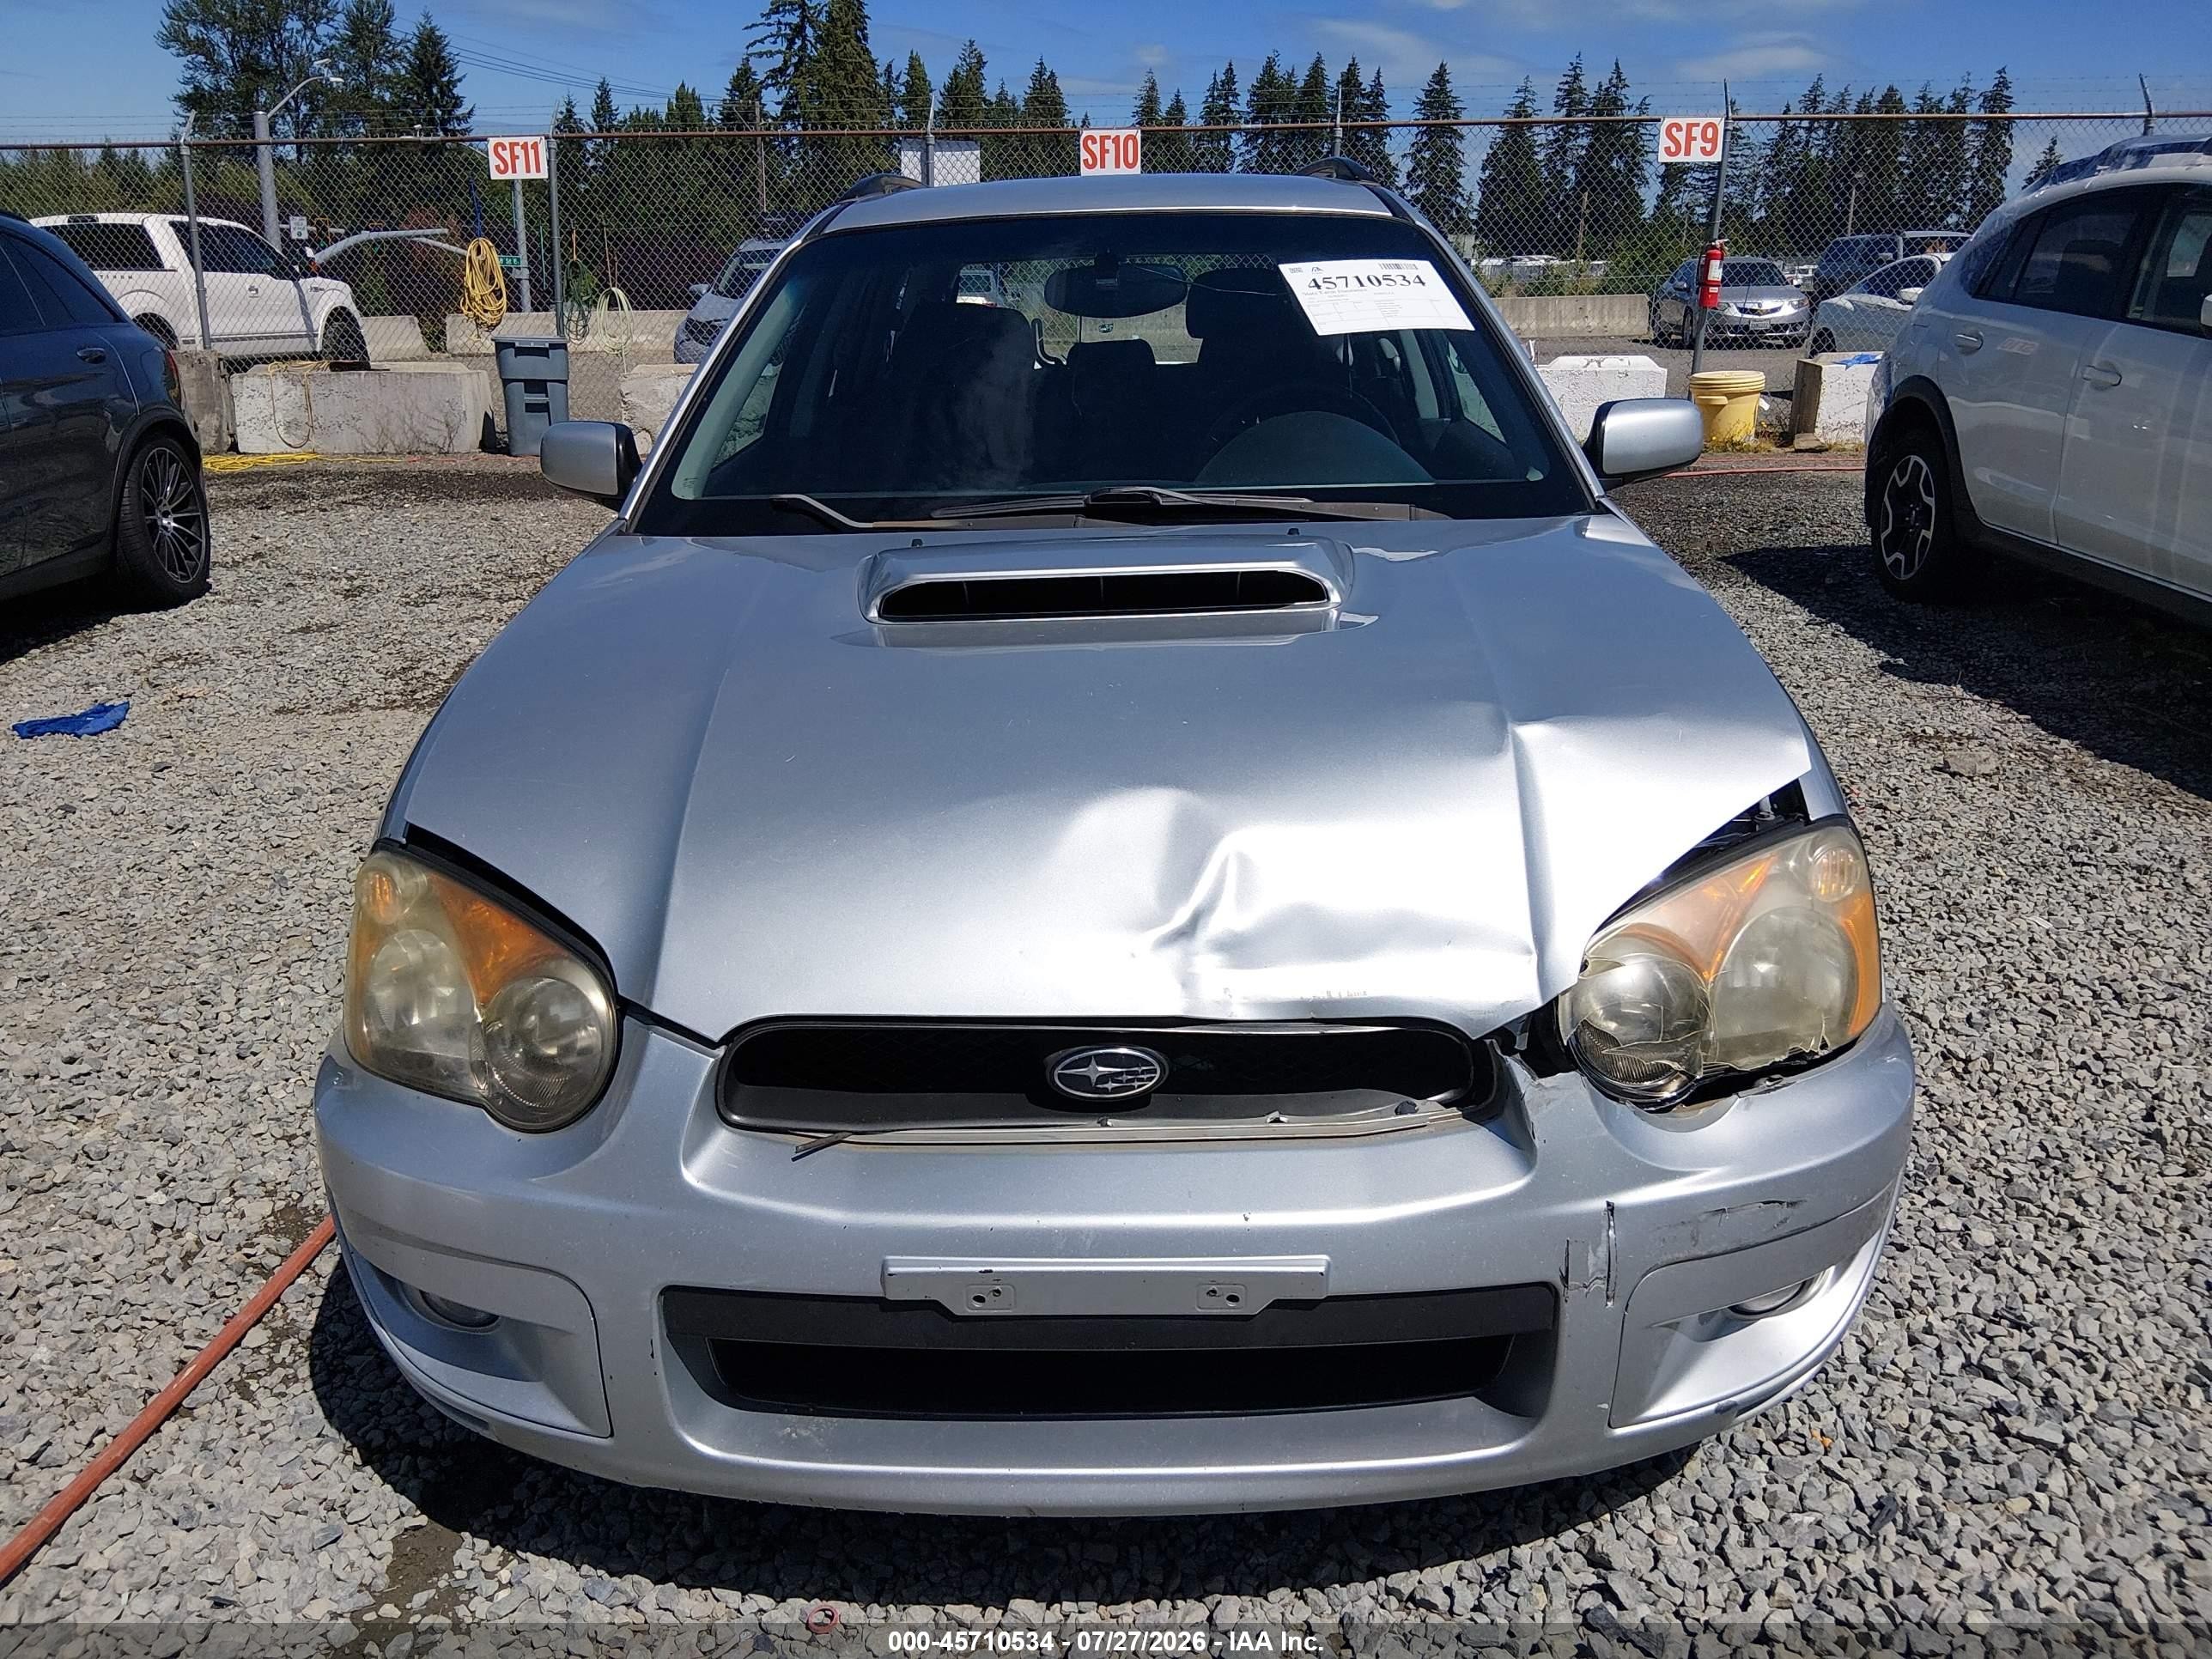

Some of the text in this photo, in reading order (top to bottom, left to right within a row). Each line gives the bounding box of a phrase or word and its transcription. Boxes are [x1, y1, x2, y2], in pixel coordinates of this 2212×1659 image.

[1082, 133, 1139, 170] SF10
[1663, 121, 1719, 157] SF9
[493, 141, 541, 174] SF11
[1308, 274, 1426, 290] 45710534
